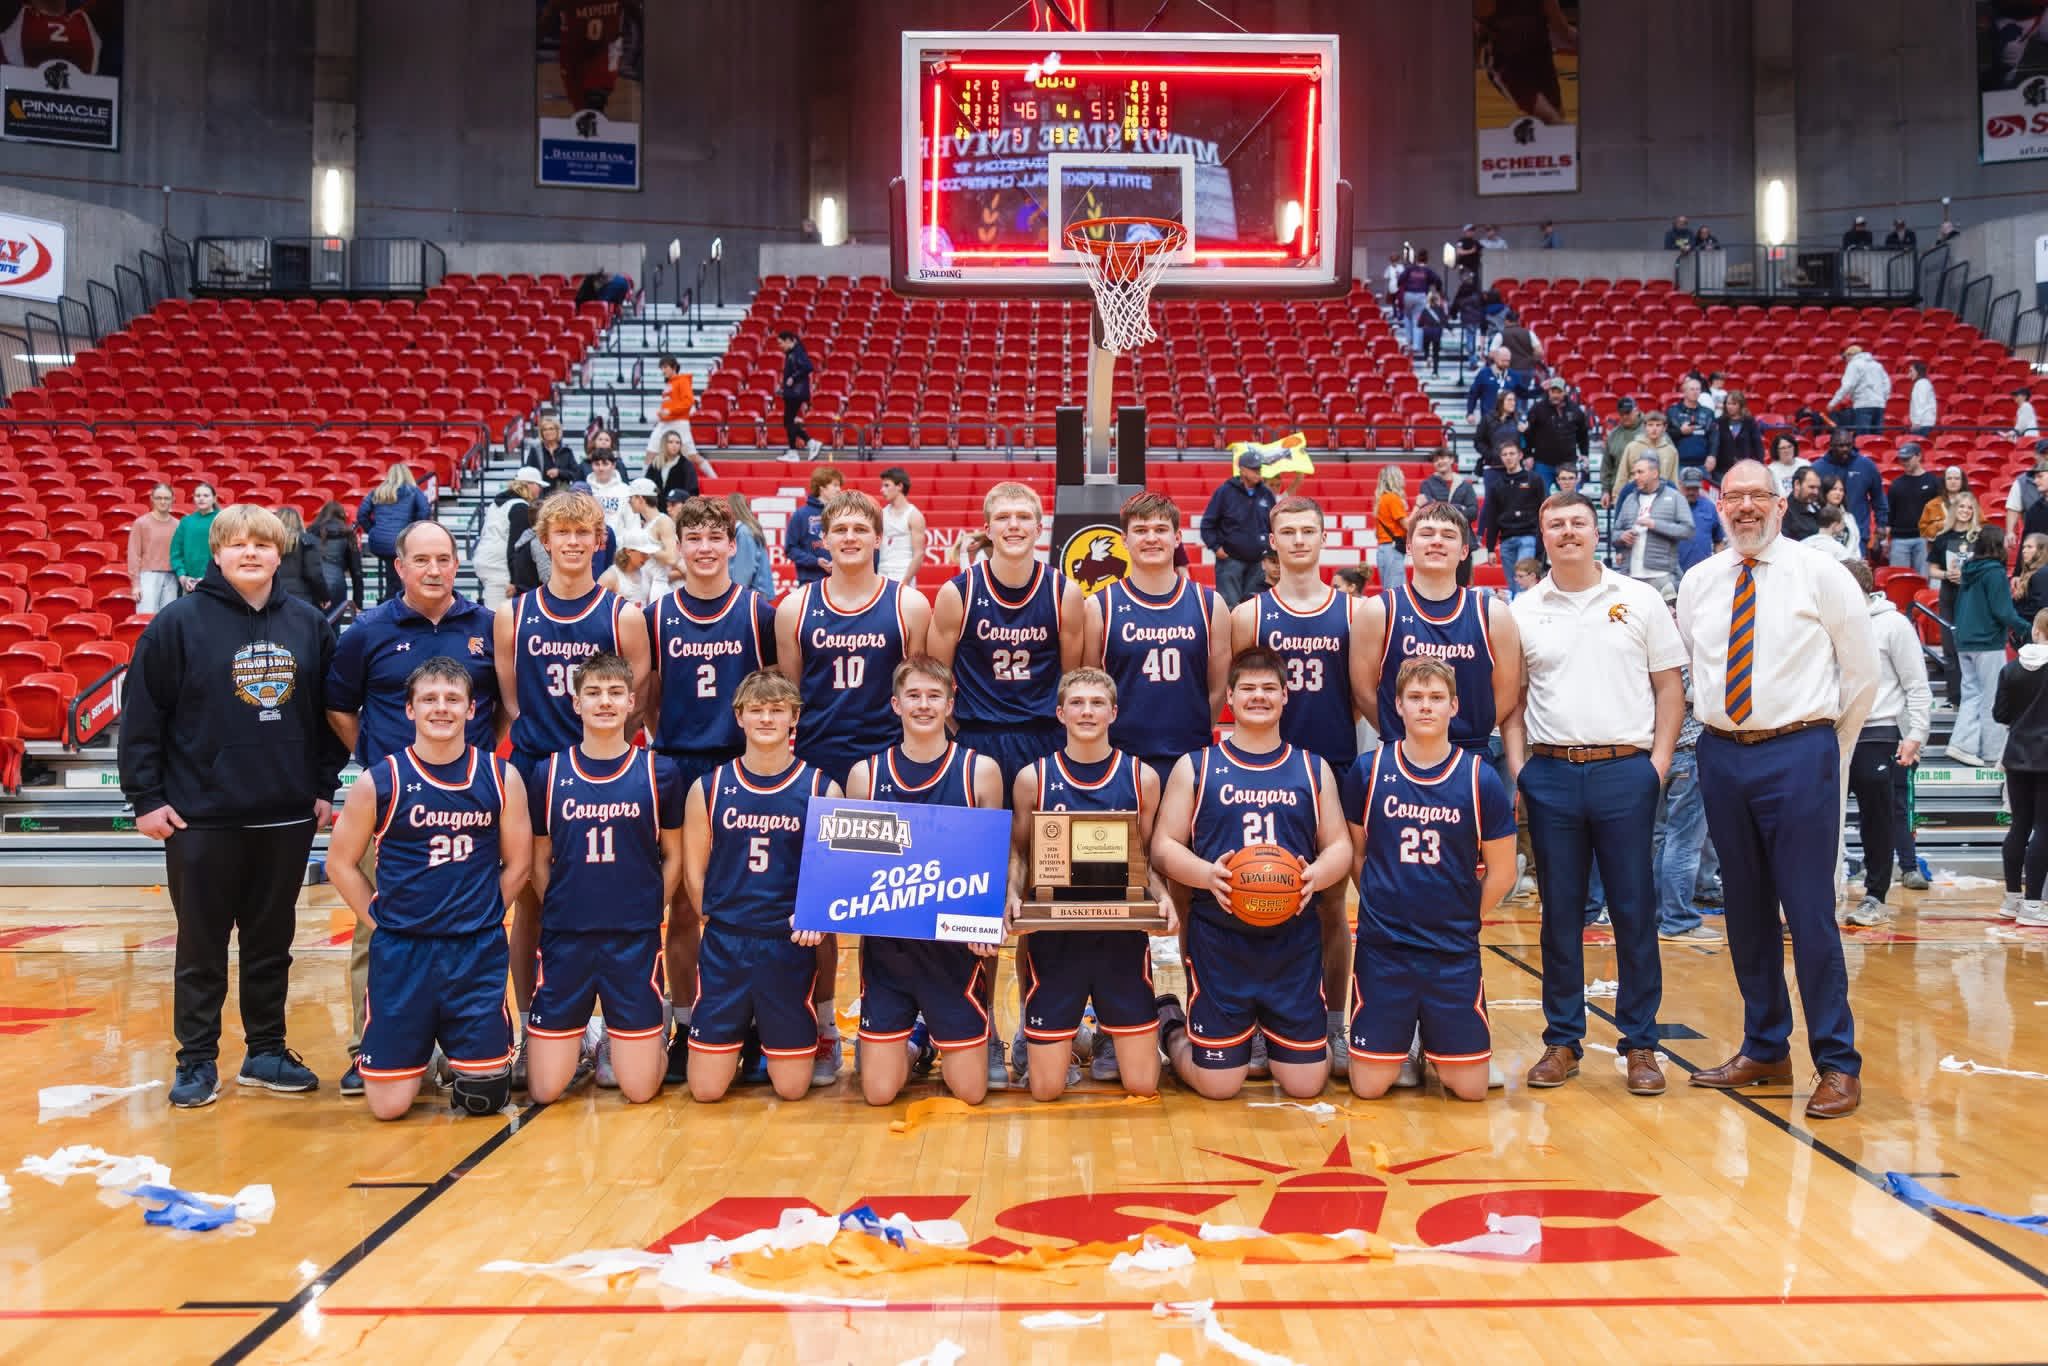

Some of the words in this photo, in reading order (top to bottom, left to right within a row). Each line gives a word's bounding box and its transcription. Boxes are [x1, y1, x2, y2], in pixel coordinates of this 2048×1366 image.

[48, 23, 69, 42] 2
[22, 100, 109, 119] PINNACLE
[1013, 101, 1037, 119] 46
[1481, 154, 1572, 171] SCHEELS
[919, 269, 962, 279] SPALDING
[812, 627, 886, 652] Cougars
[976, 618, 1048, 646] Cougars
[1121, 622, 1196, 645] Cougars
[1268, 631, 1340, 654] Cougars
[668, 637, 742, 660] Cougars
[1402, 635, 1475, 660] Cougars
[832, 656, 865, 689] 10
[992, 649, 1031, 681] 22
[1142, 648, 1181, 682] 40
[1287, 658, 1324, 692] 33
[697, 664, 716, 698] 2
[1219, 784, 1297, 808] Cougars
[409, 804, 492, 829] Cougars
[562, 798, 641, 823] Cougars
[722, 807, 801, 834] Cougars
[1383, 795, 1461, 824] Cougars
[820, 816, 911, 847] NDHSAA
[1243, 812, 1278, 847] 21
[428, 834, 473, 867] 20
[585, 827, 616, 864] 11
[748, 836, 770, 873] 5
[1400, 828, 1441, 865] 23
[870, 860, 942, 892] 2026
[1240, 872, 1294, 887] SPALDING
[828, 872, 990, 921] CHAMPION
[1060, 908, 1121, 916] BASKETBALL
[951, 925, 977, 933] CHOICE
[978, 927, 999, 935] BANK
